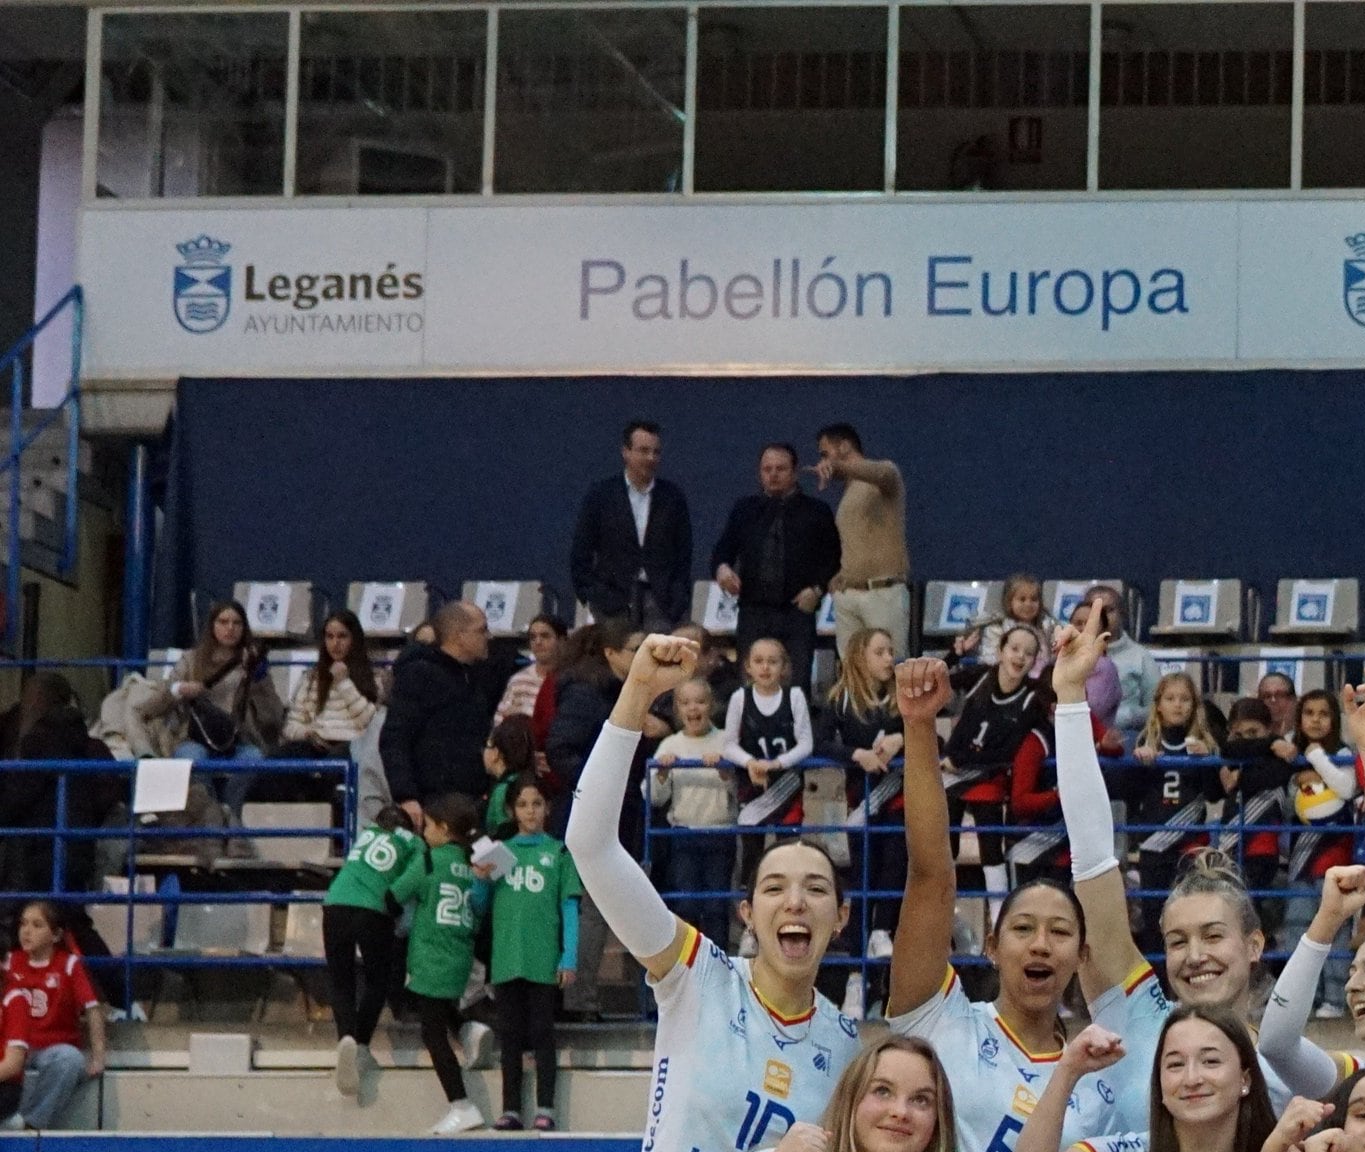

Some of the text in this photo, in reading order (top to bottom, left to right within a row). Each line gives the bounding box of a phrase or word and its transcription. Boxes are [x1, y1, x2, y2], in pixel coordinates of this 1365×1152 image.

[245, 263, 423, 310] Leganés
[579, 256, 1189, 330] Pabellón Europa
[244, 313, 424, 334] AYUNTAMIENTO
[1163, 771, 1180, 798] 2
[505, 865, 545, 893] 46
